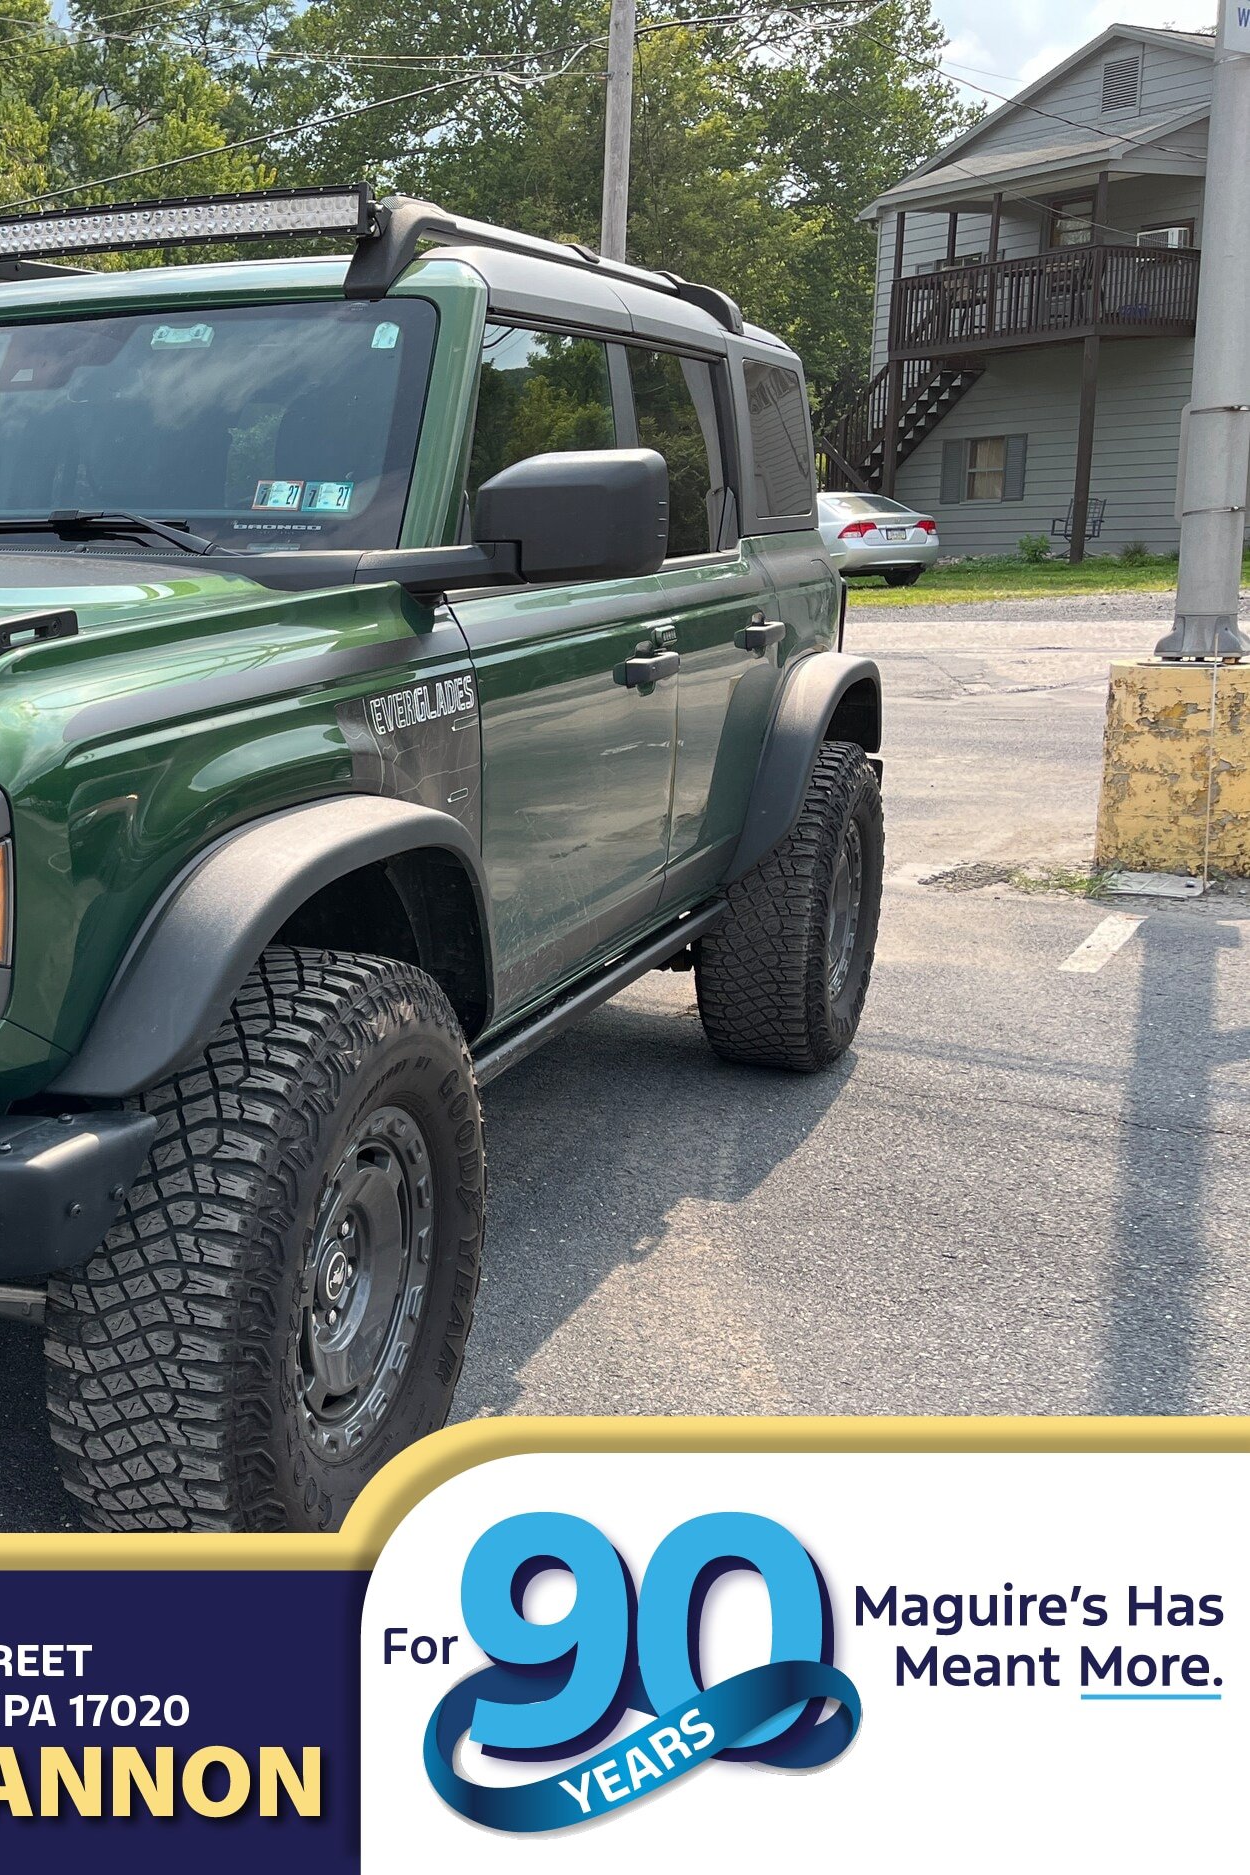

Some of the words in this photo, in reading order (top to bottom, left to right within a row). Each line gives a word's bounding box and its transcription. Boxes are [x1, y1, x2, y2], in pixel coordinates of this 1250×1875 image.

[286, 485, 299, 505] 27
[336, 486, 349, 506] 27
[233, 523, 321, 531] BRONCO
[370, 675, 474, 735] EVERGLADES
